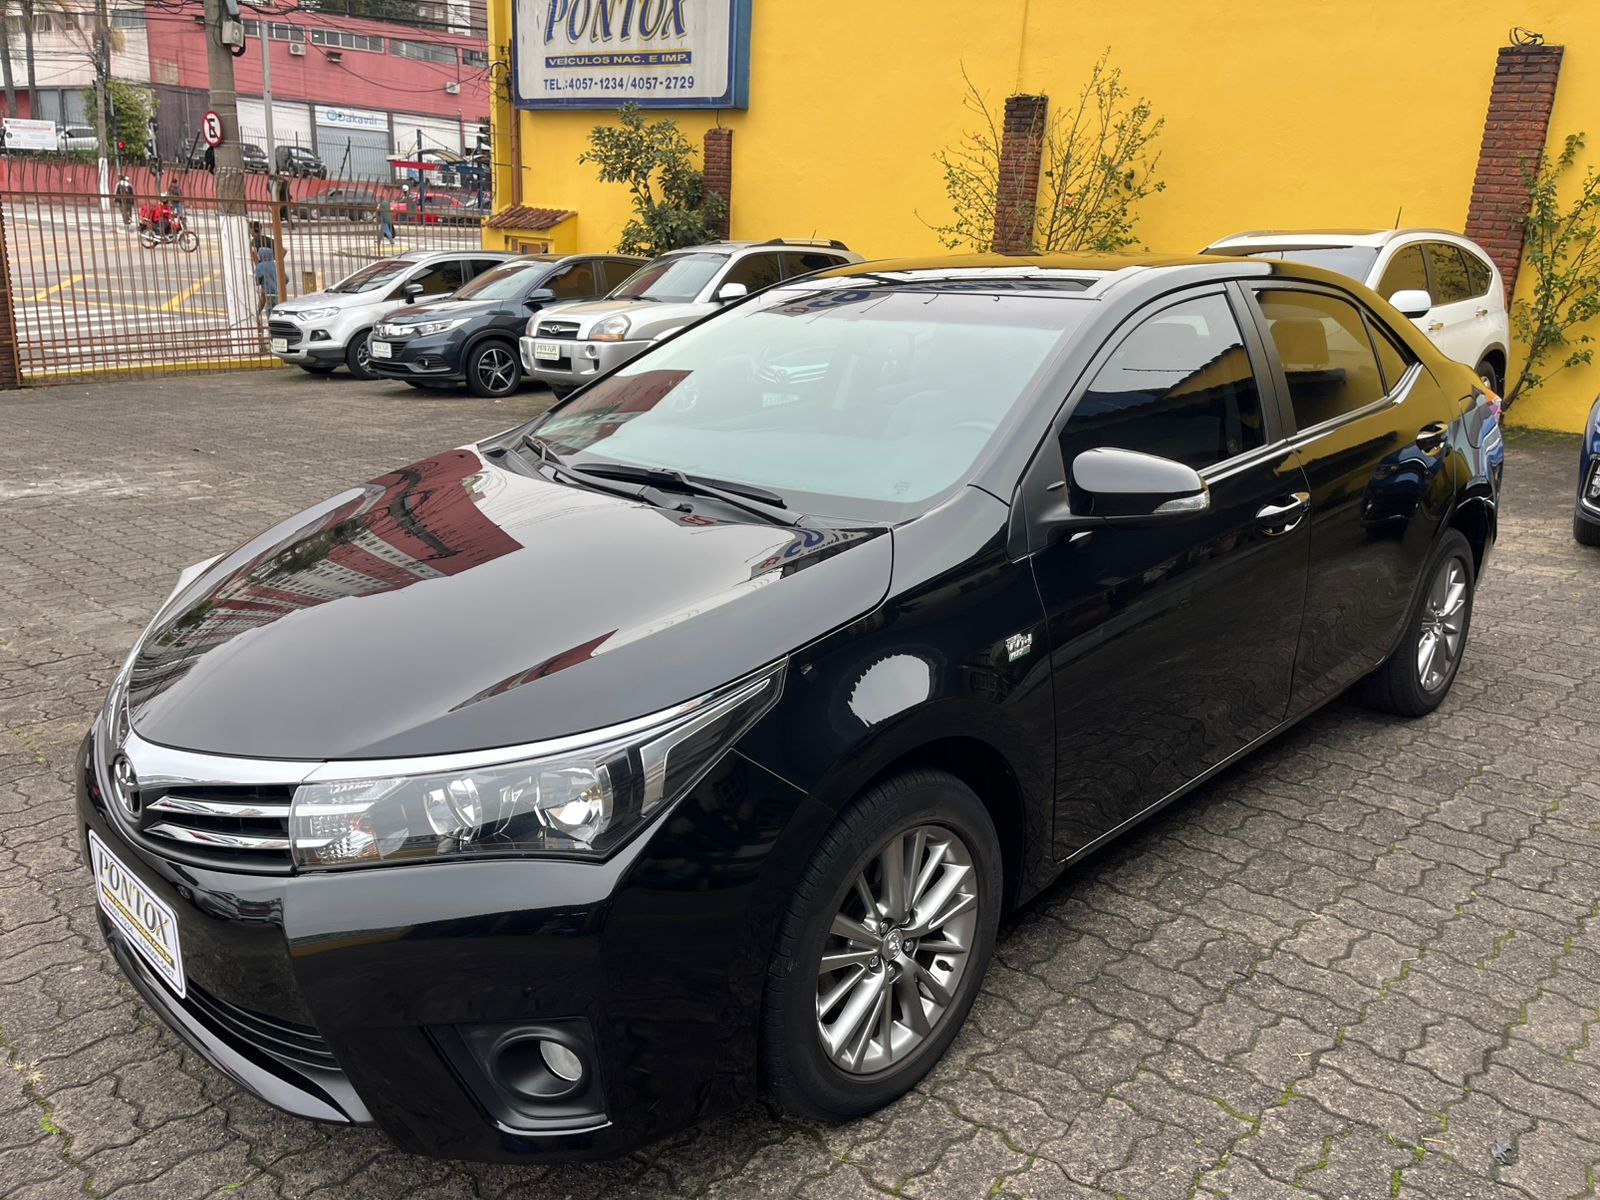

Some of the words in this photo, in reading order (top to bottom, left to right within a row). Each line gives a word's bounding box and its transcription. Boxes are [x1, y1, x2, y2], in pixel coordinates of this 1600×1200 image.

[613, 55, 645, 64] NAC.
[662, 53, 689, 62] IMP.
[98, 848, 171, 950] PONTOX
